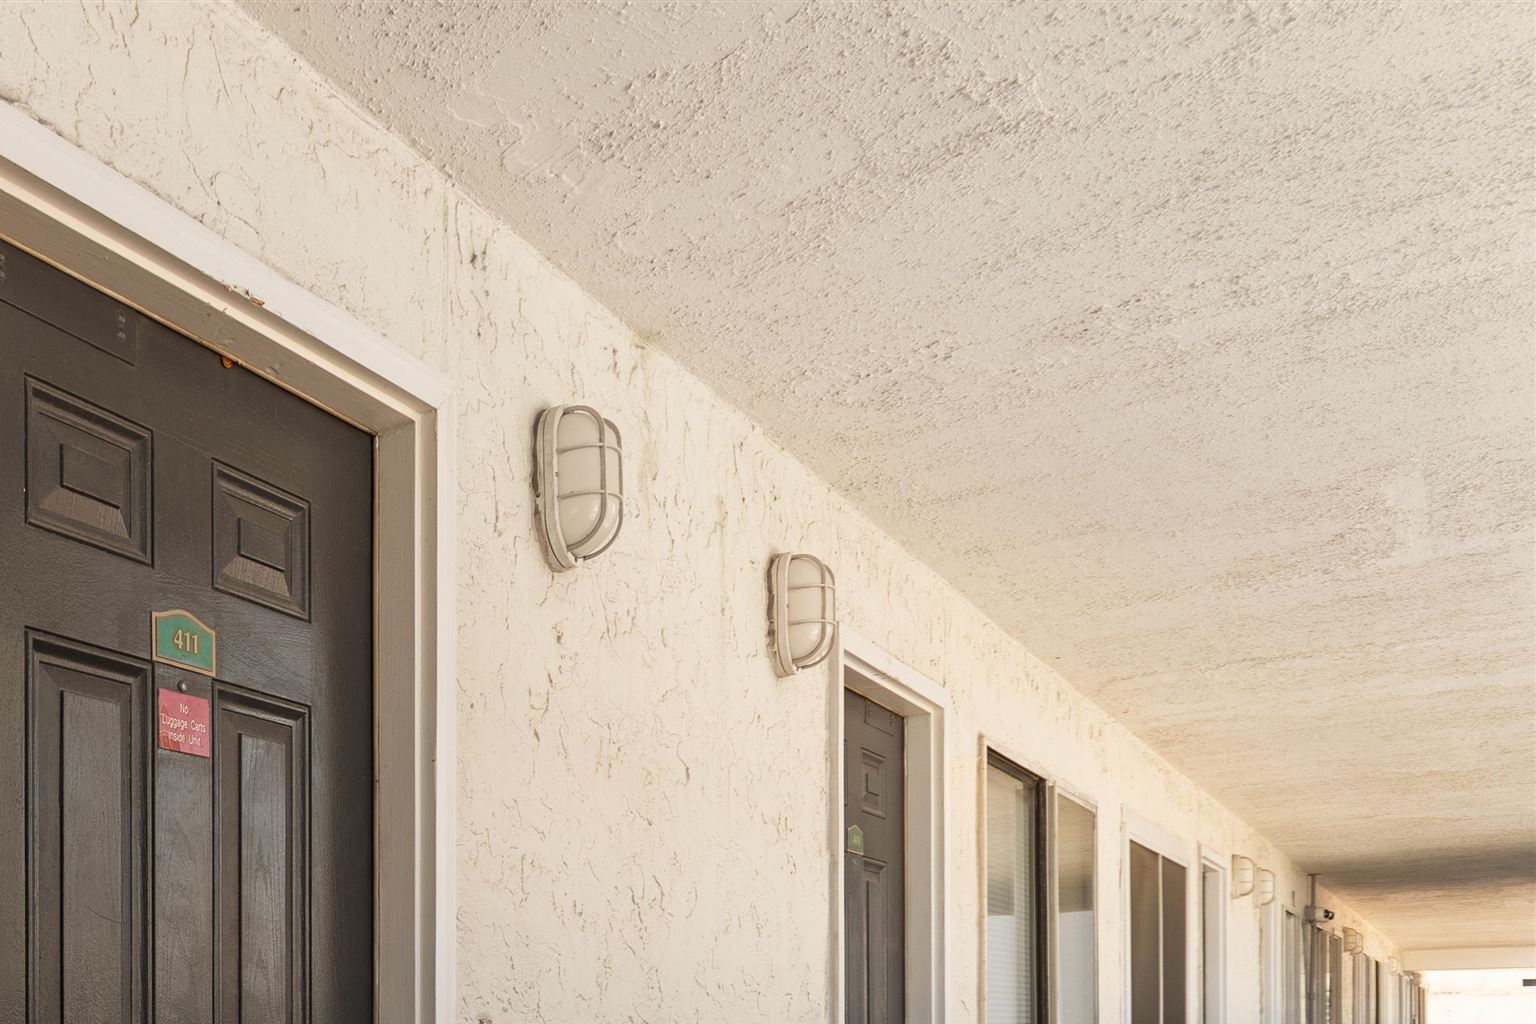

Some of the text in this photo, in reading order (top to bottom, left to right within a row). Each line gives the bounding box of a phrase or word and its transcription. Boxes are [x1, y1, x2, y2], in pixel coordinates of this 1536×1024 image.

[173, 629, 199, 654] 411
[179, 703, 189, 715] No
[162, 715, 188, 731] Luggage
